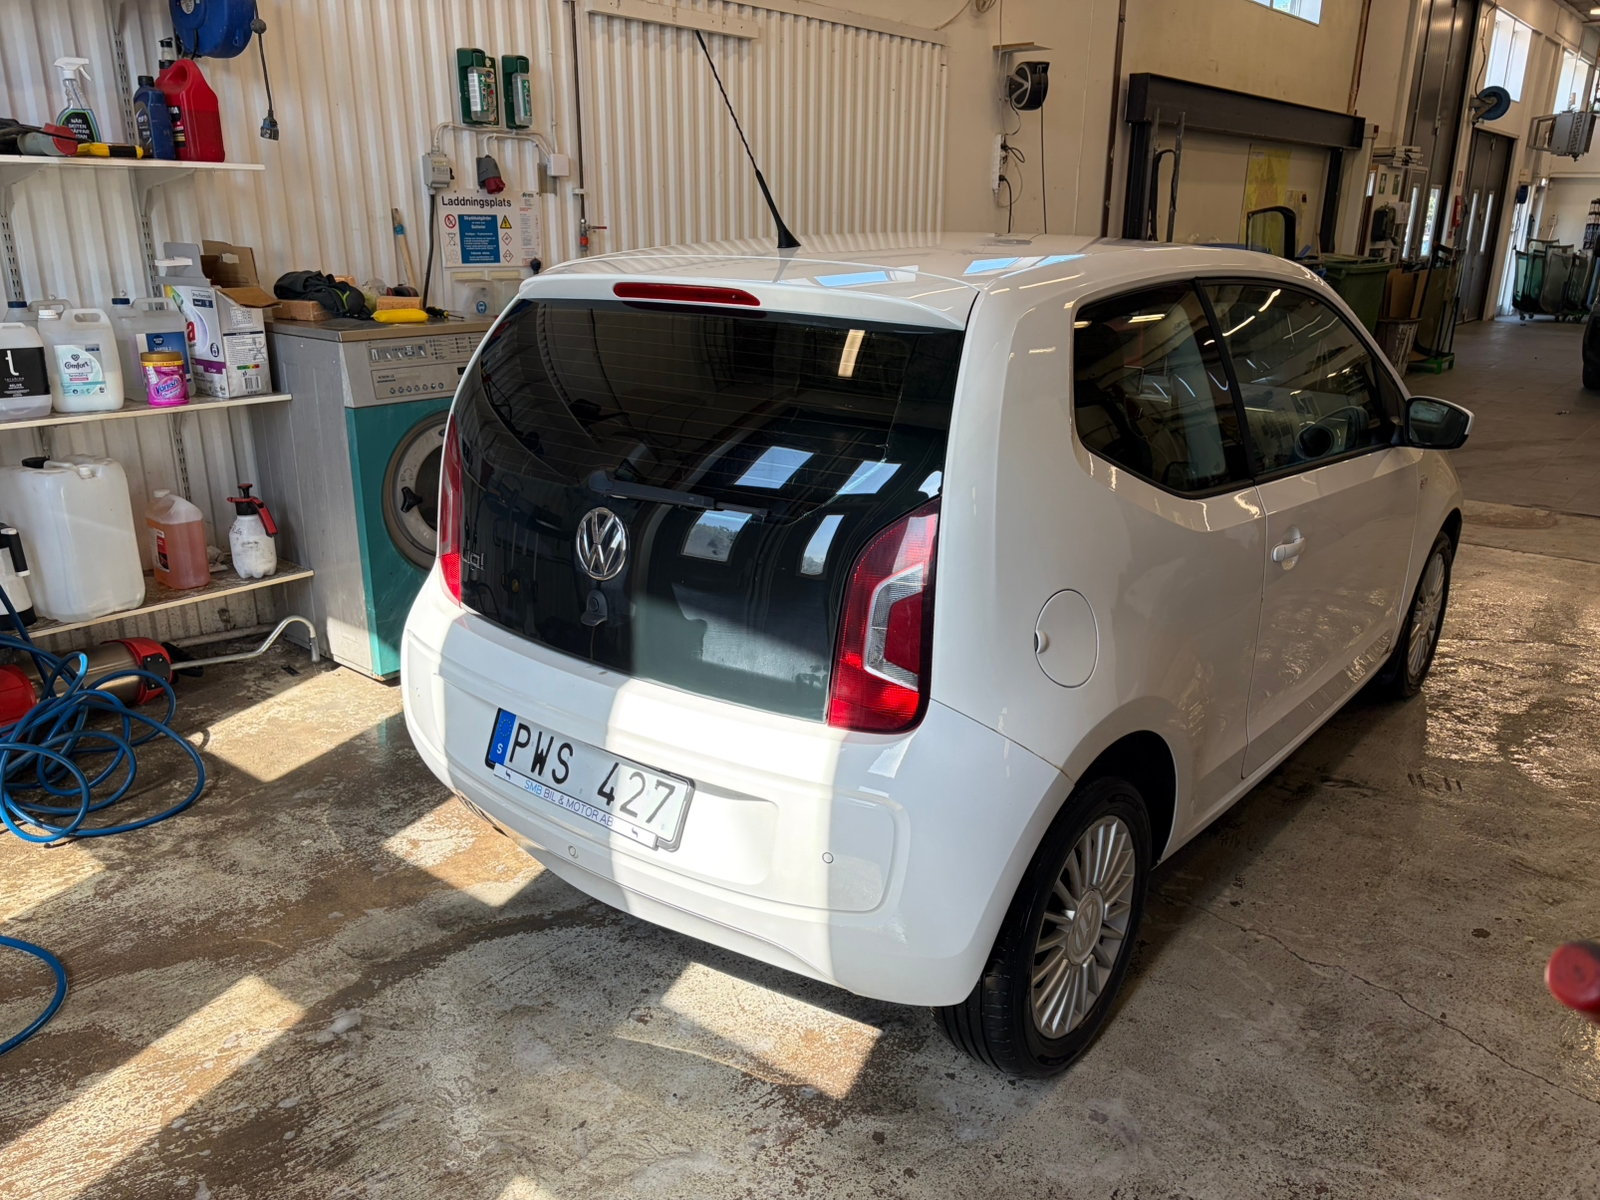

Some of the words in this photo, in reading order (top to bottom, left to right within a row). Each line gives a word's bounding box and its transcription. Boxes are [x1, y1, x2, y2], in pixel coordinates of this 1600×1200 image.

[441, 196, 512, 209] Laddningsplats
[64, 361, 90, 370] Comfort
[155, 378, 179, 395] Vanish
[496, 743, 504, 755] S
[509, 722, 574, 785] PWS
[597, 762, 676, 824] 427
[524, 780, 543, 795] SMB
[543, 788, 556, 802] BIL
[558, 795, 564, 806] &
[565, 798, 599, 821] MOTOR
[599, 814, 614, 827] AB
